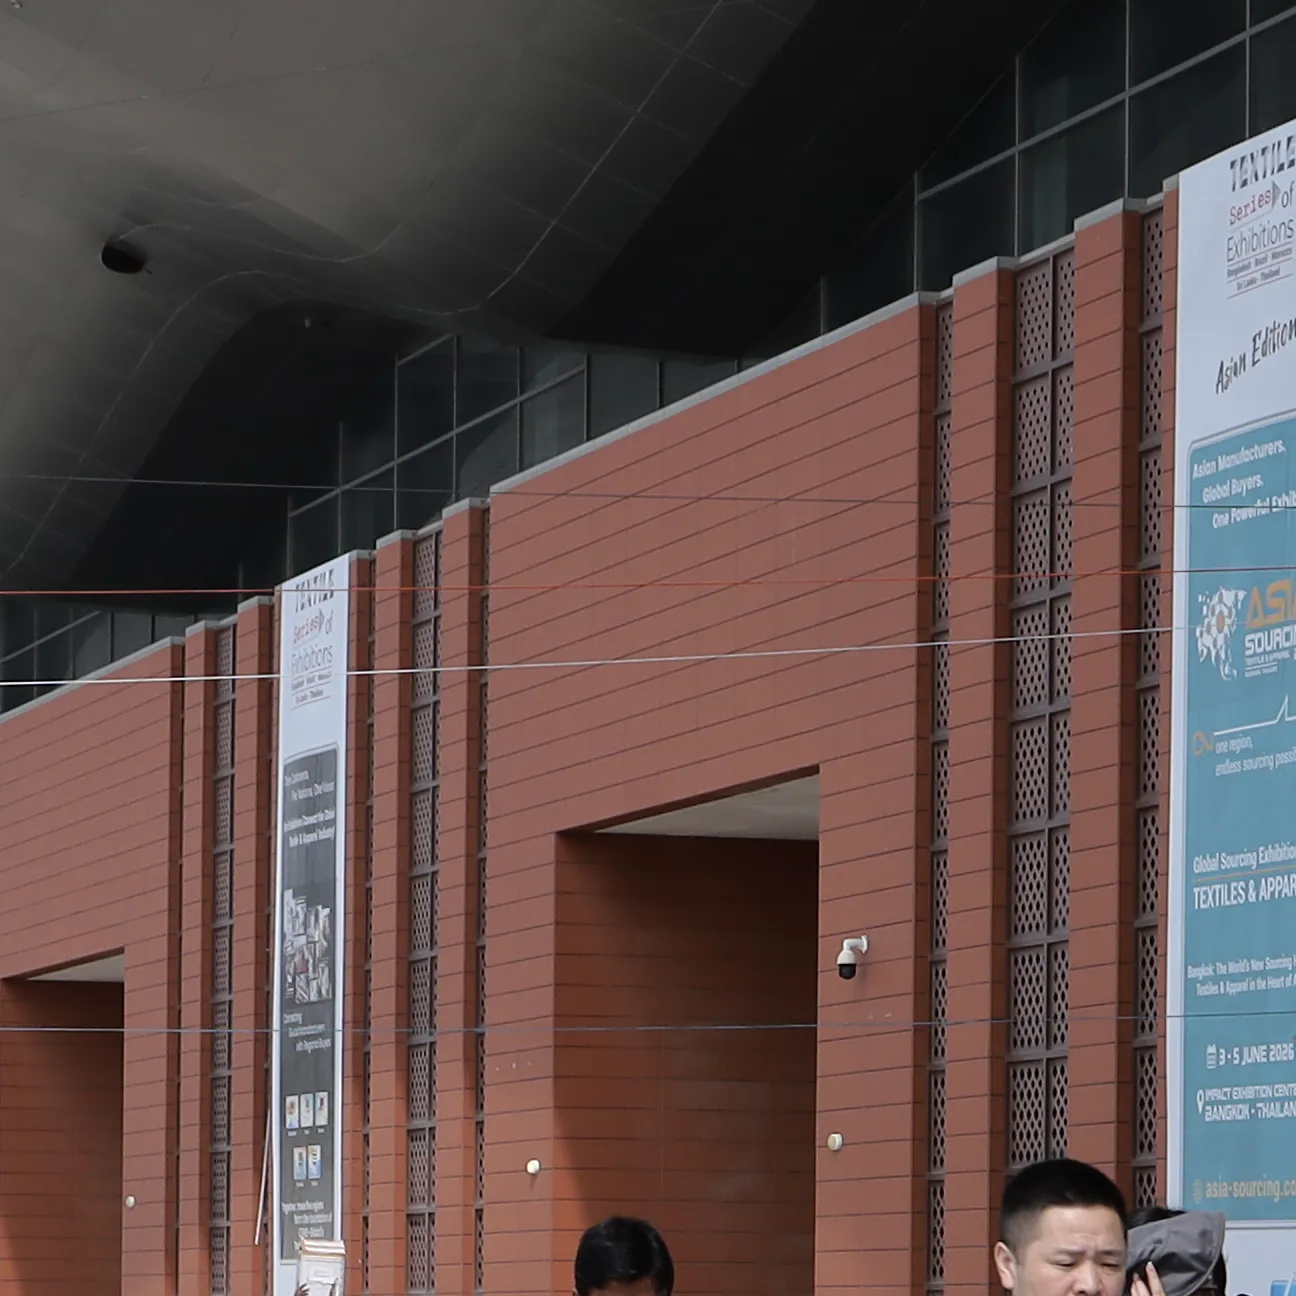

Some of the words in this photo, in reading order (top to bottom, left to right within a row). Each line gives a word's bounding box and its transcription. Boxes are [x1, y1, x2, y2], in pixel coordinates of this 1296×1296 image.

[1230, 135, 1296, 192] TEXTILE
[1229, 188, 1272, 226] Series
[1281, 180, 1295, 209] of
[1227, 218, 1294, 262] Exhibitions
[1215, 350, 1246, 395] Asian
[1192, 457, 1216, 479] Asian
[1202, 482, 1230, 504] Global
[1212, 511, 1230, 529] One
[1230, 498, 1270, 525] Powerful
[1193, 853, 1219, 873] Global
[1221, 849, 1257, 869] Sourcing
[1193, 881, 1246, 909] TEXTILES
[1248, 879, 1256, 902] &
[1219, 1048, 1226, 1066] 3
[1241, 1045, 1268, 1066] JUNE
[1269, 1043, 1295, 1062] 2026
[1205, 1103, 1250, 1122] BANGKOK
